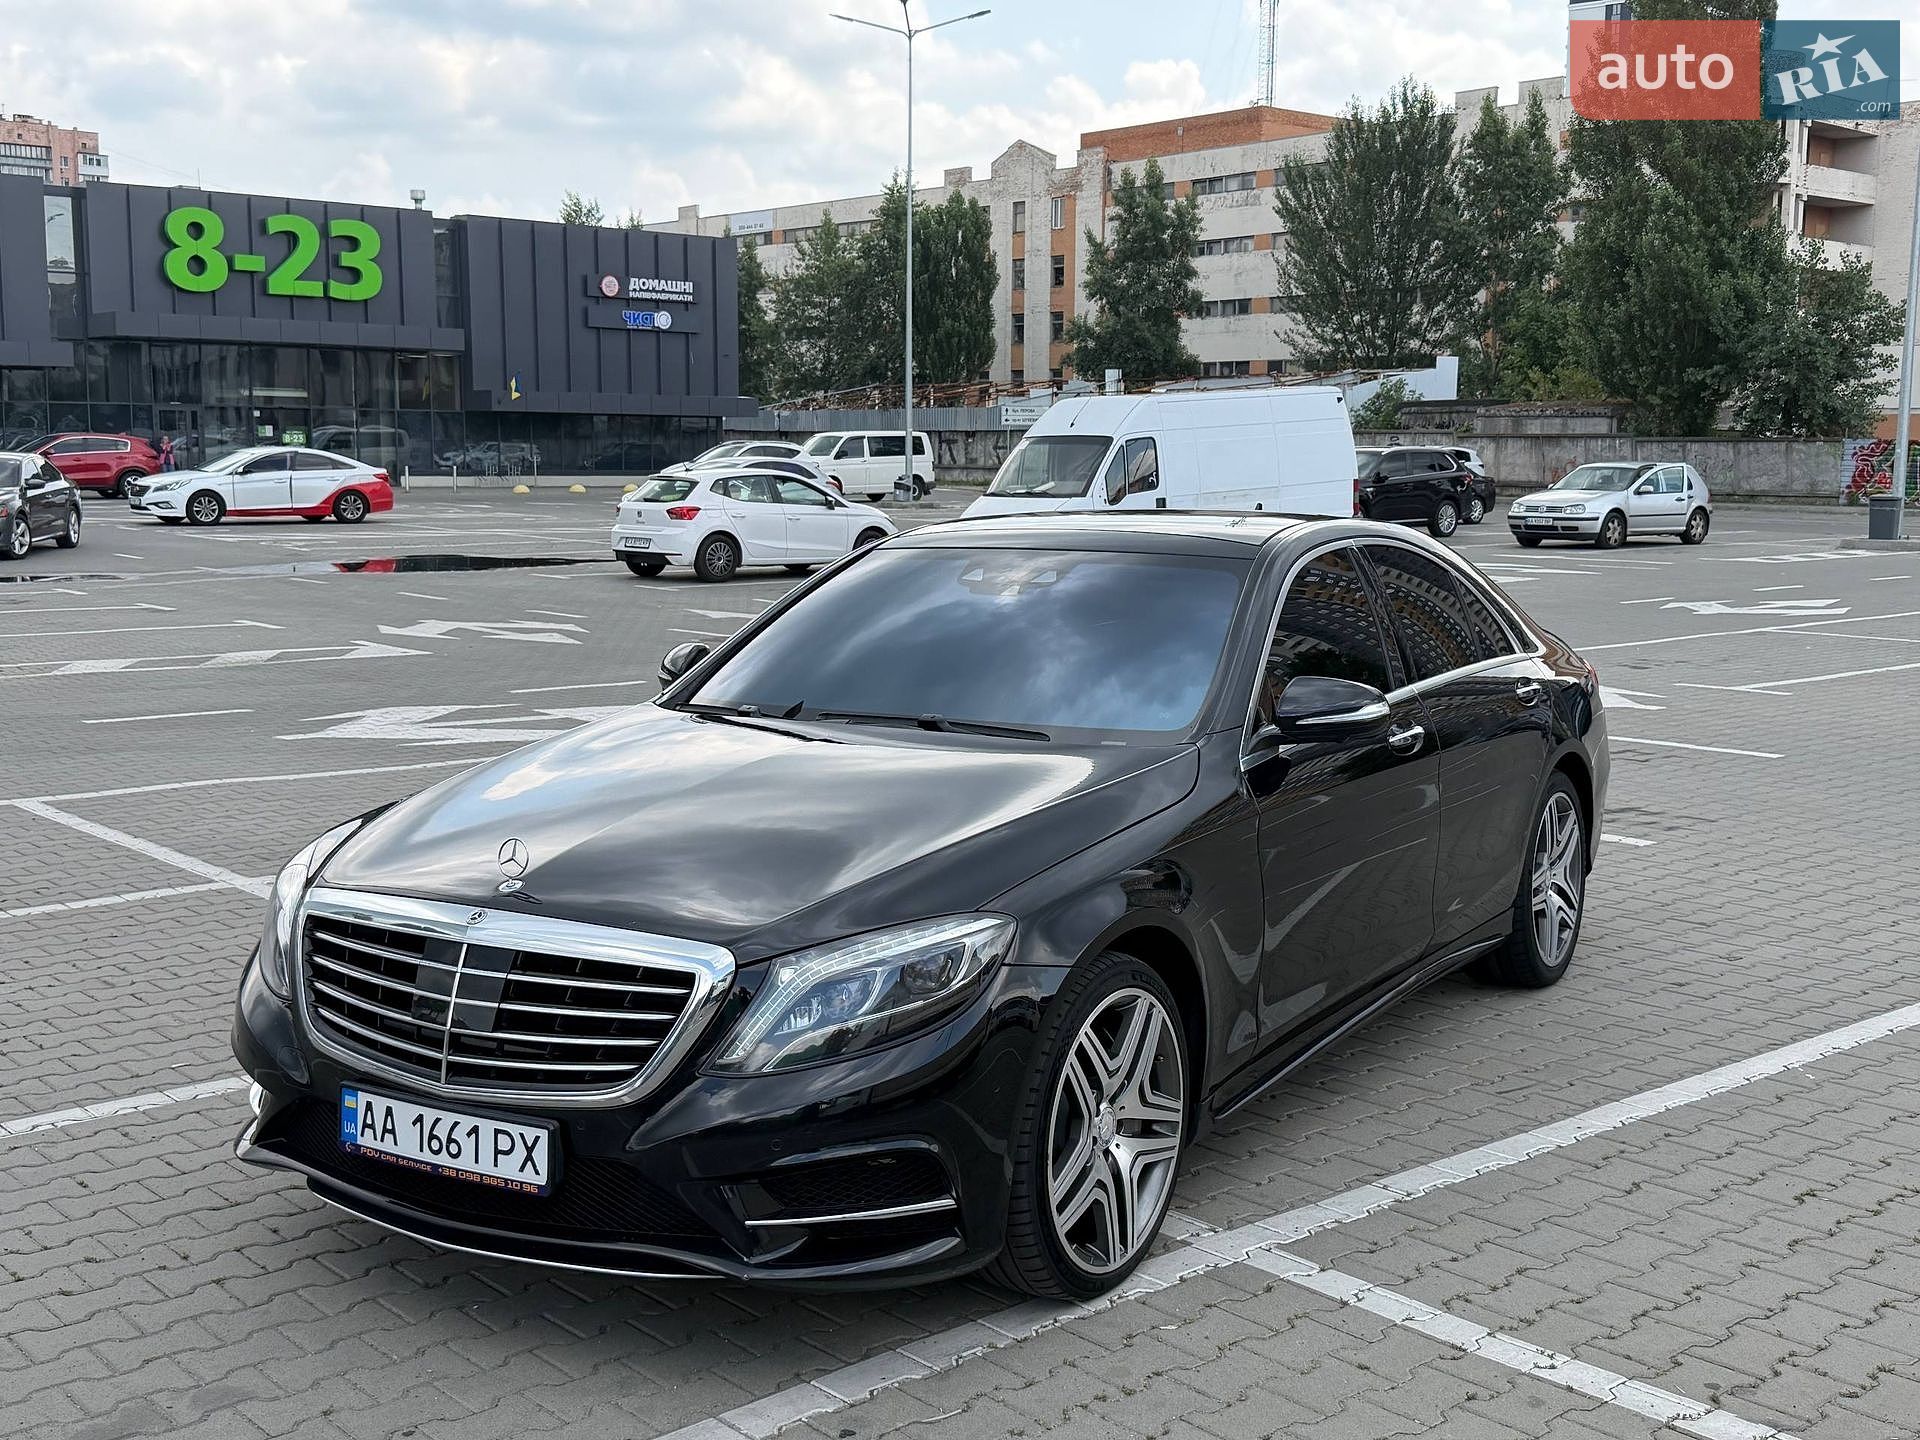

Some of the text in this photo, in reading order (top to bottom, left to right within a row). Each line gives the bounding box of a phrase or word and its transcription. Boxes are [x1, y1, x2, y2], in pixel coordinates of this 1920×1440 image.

[163, 206, 384, 302] 8-23
[628, 277, 694, 294] ДОМАШНІ
[344, 1120, 357, 1135] UA
[360, 1100, 542, 1177] AA 1661 PX
[438, 1166, 457, 1177] +38
[458, 1170, 481, 1182] 098
[506, 1180, 521, 1190] 10
[522, 1183, 539, 1193] 96
